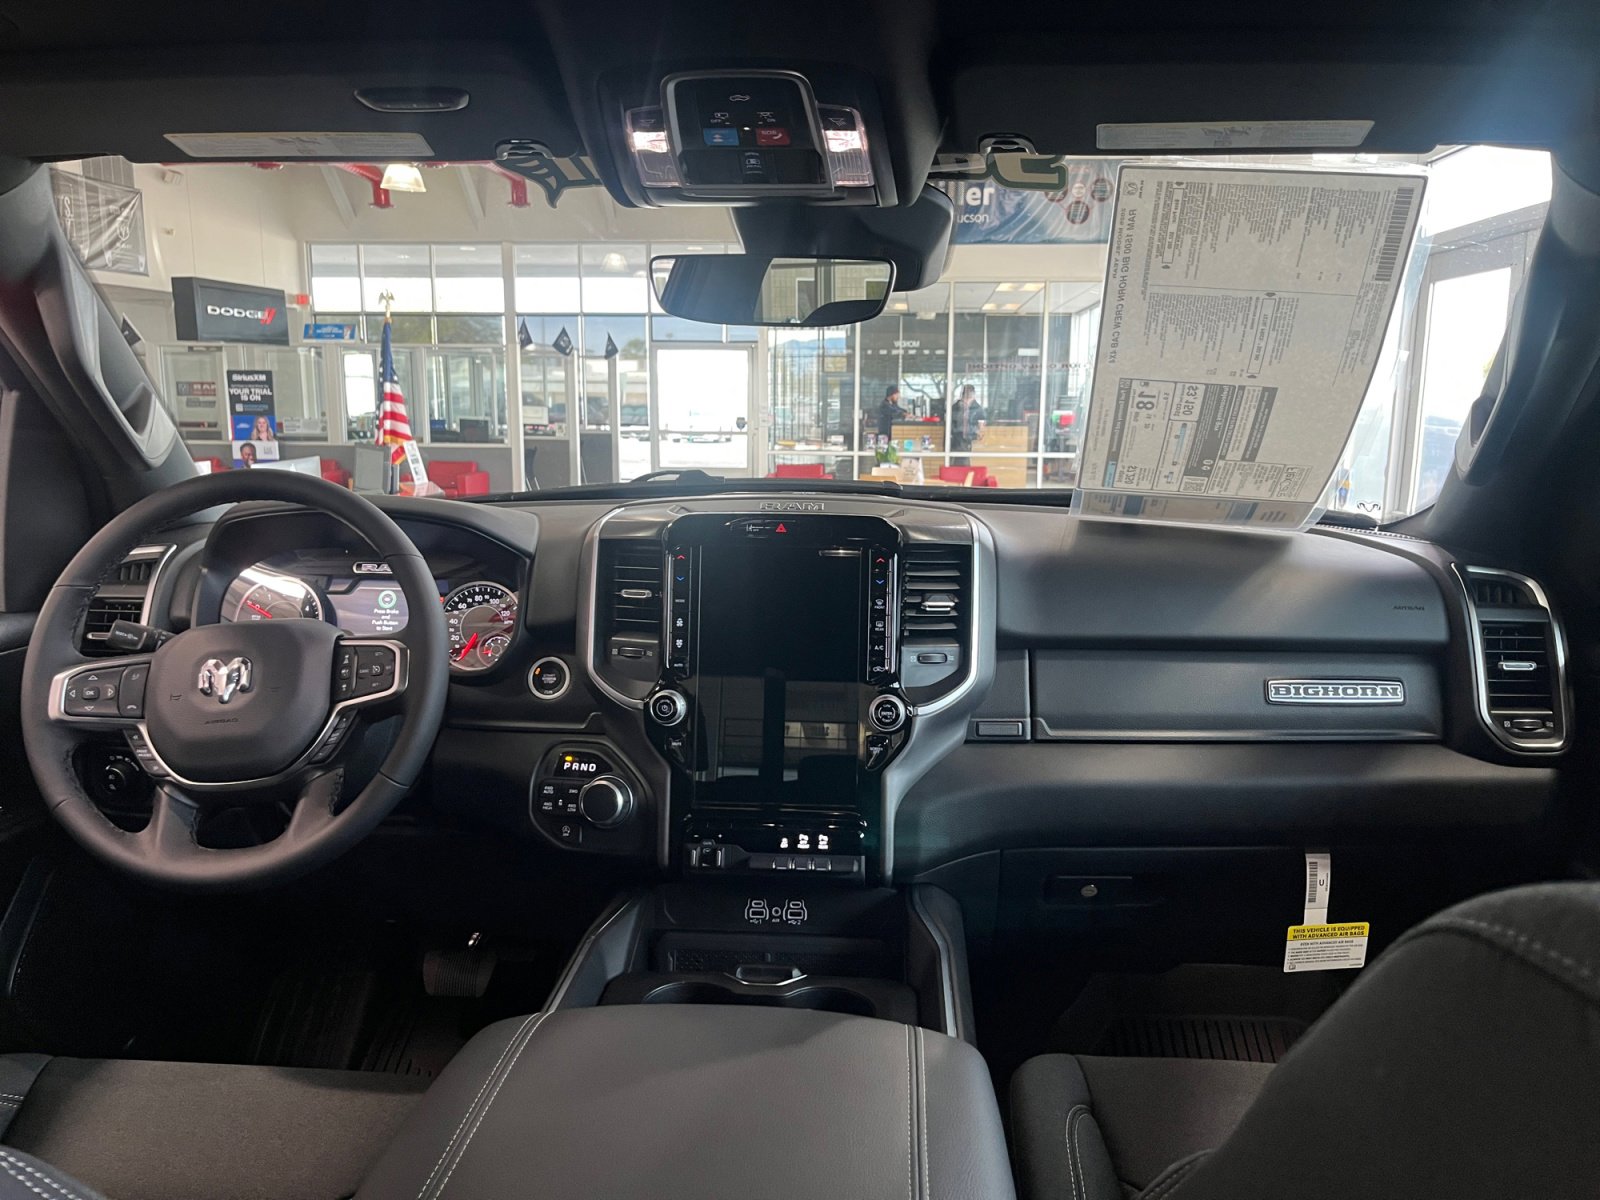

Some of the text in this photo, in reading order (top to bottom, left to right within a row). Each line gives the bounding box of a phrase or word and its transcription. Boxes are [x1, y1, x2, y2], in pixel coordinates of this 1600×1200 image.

[207, 305, 269, 319] DODGE
[232, 373, 266, 381] SiriusXM
[760, 502, 825, 511] RAM
[361, 563, 392, 572] RA
[1272, 685, 1400, 697] BIGHORN
